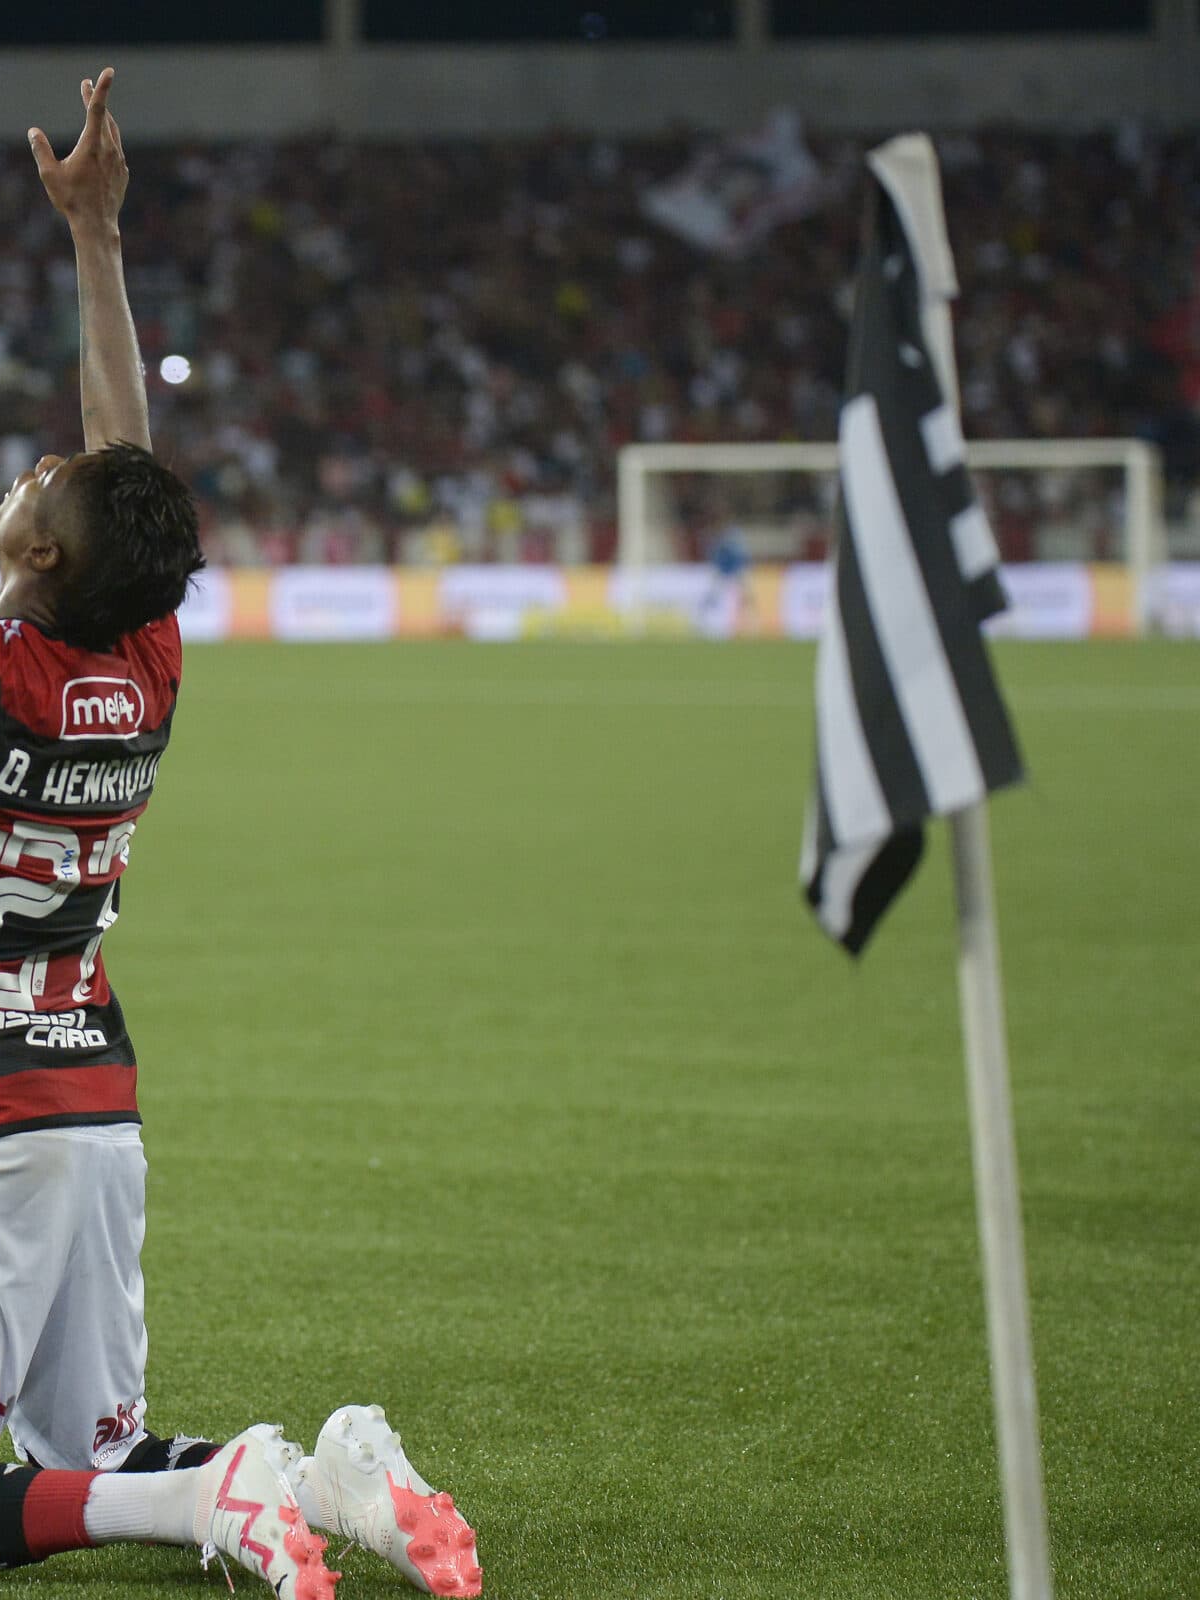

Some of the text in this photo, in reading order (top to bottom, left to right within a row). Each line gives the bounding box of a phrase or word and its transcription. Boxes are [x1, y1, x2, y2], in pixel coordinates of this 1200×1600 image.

[40, 752, 161, 804] HENRIQU
[61, 849, 75, 879] TIM
[25, 1025, 108, 1048] CARD
